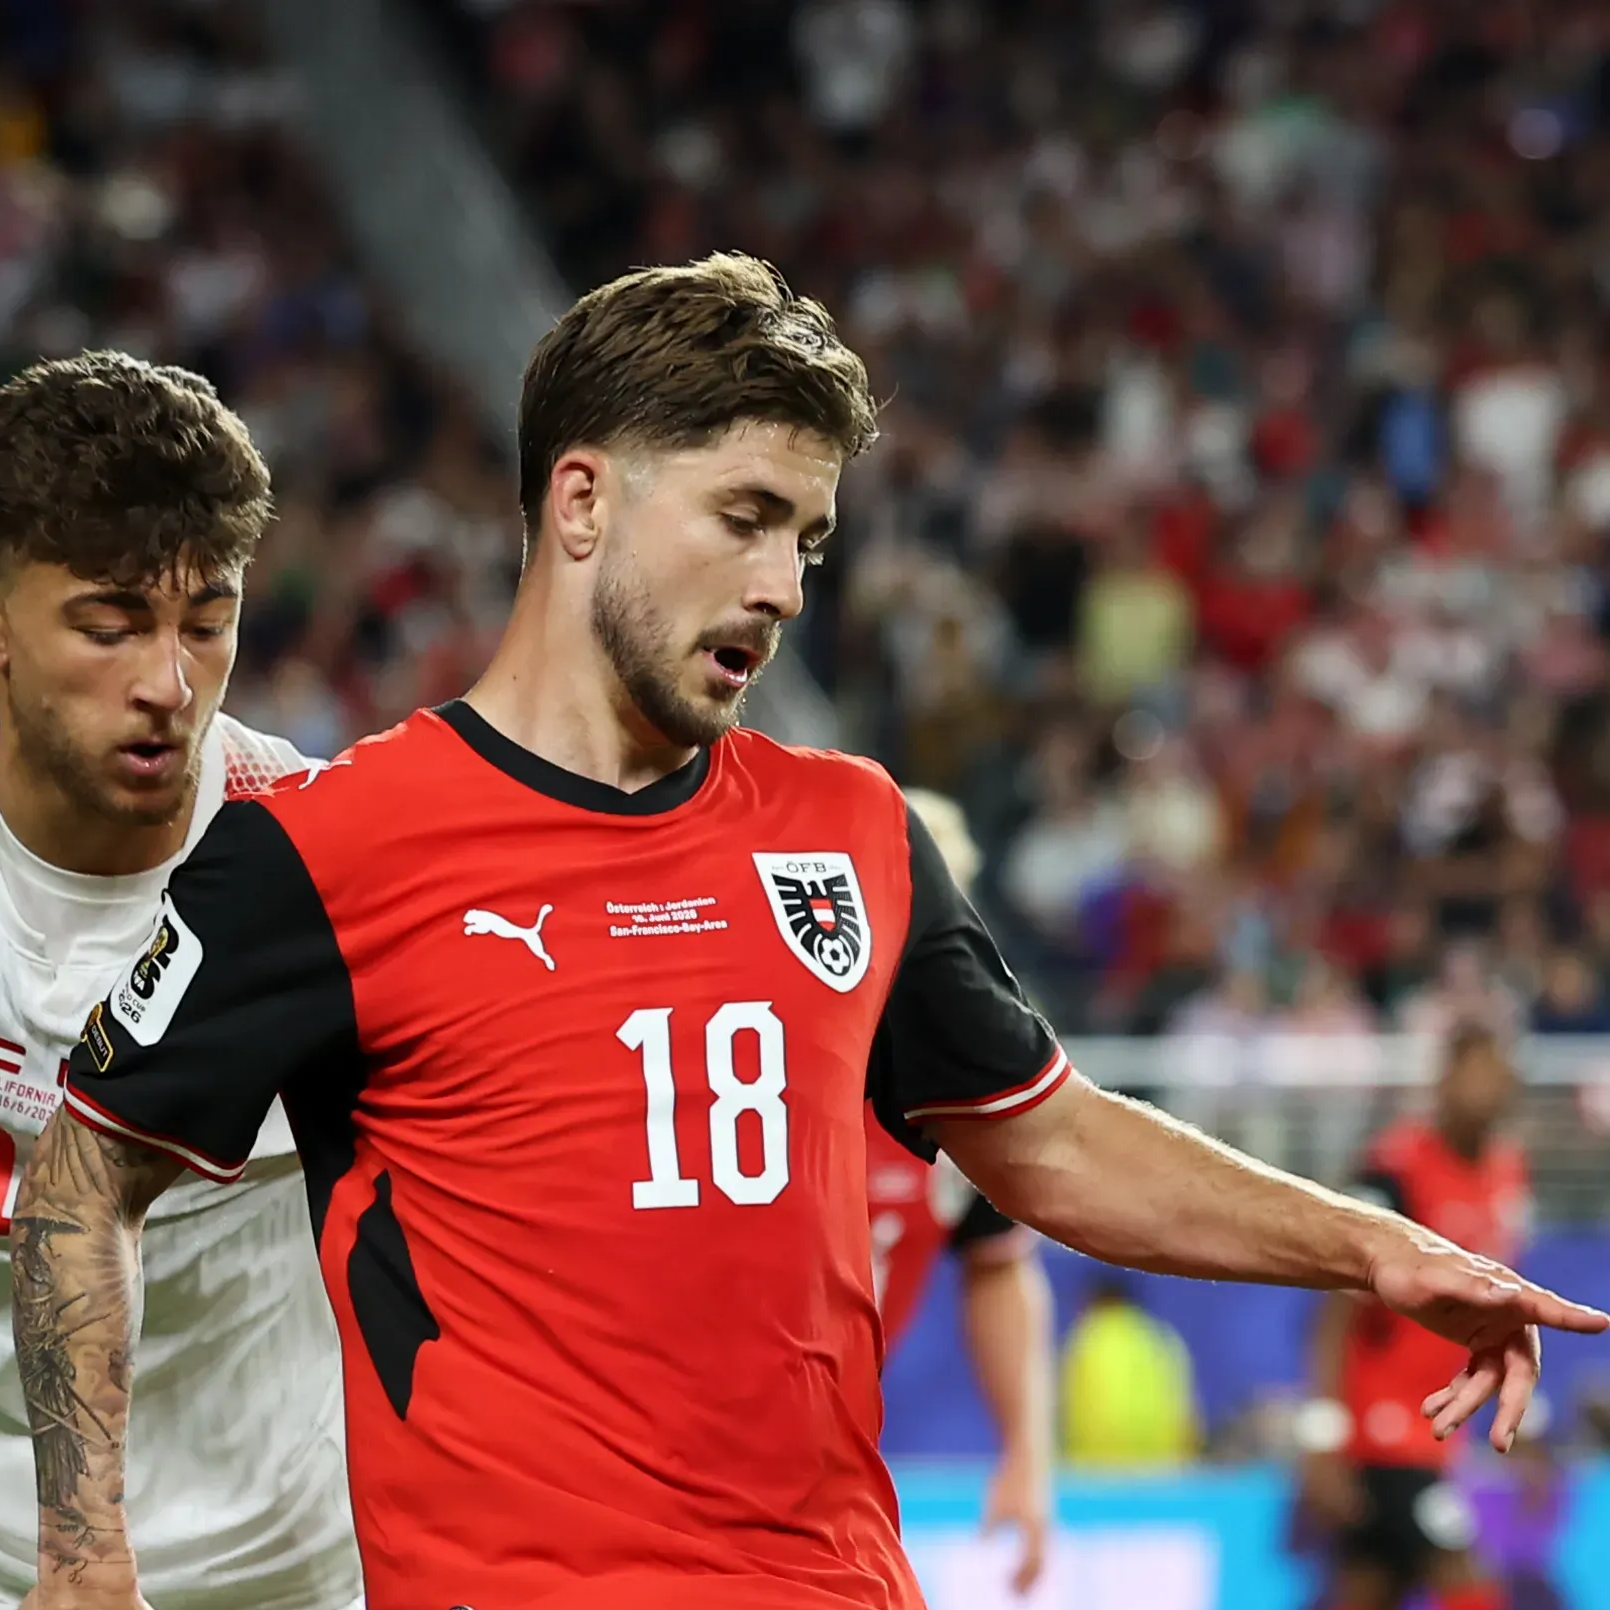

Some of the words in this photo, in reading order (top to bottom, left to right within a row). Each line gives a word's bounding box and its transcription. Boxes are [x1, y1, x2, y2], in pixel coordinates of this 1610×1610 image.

[786, 861, 827, 873] ÖFB
[665, 896, 716, 911] Jordanien
[615, 1000, 790, 1210] 18
